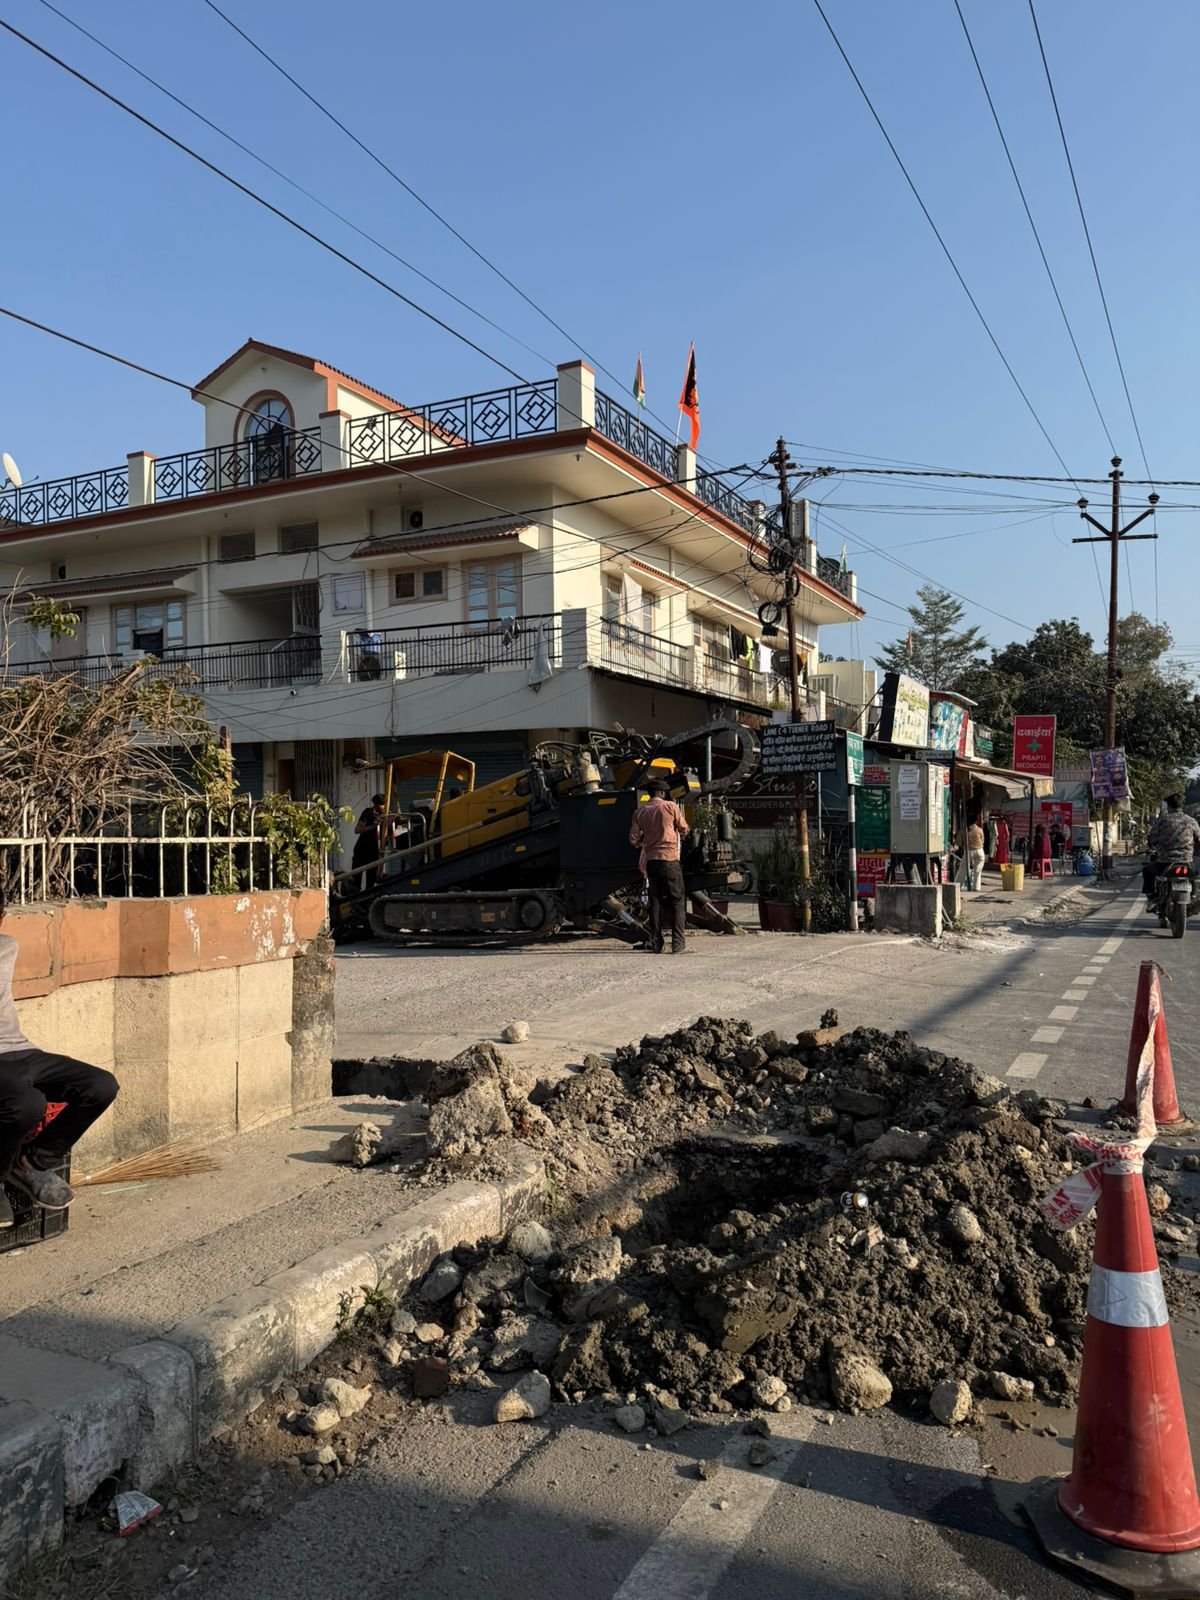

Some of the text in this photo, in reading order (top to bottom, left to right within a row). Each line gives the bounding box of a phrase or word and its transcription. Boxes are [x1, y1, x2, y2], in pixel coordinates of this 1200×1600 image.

[764, 728, 777, 736] LANE
[788, 725, 809, 734] TURNER
[811, 724, 828, 732] ROAD
[752, 773, 817, 795] Studo
